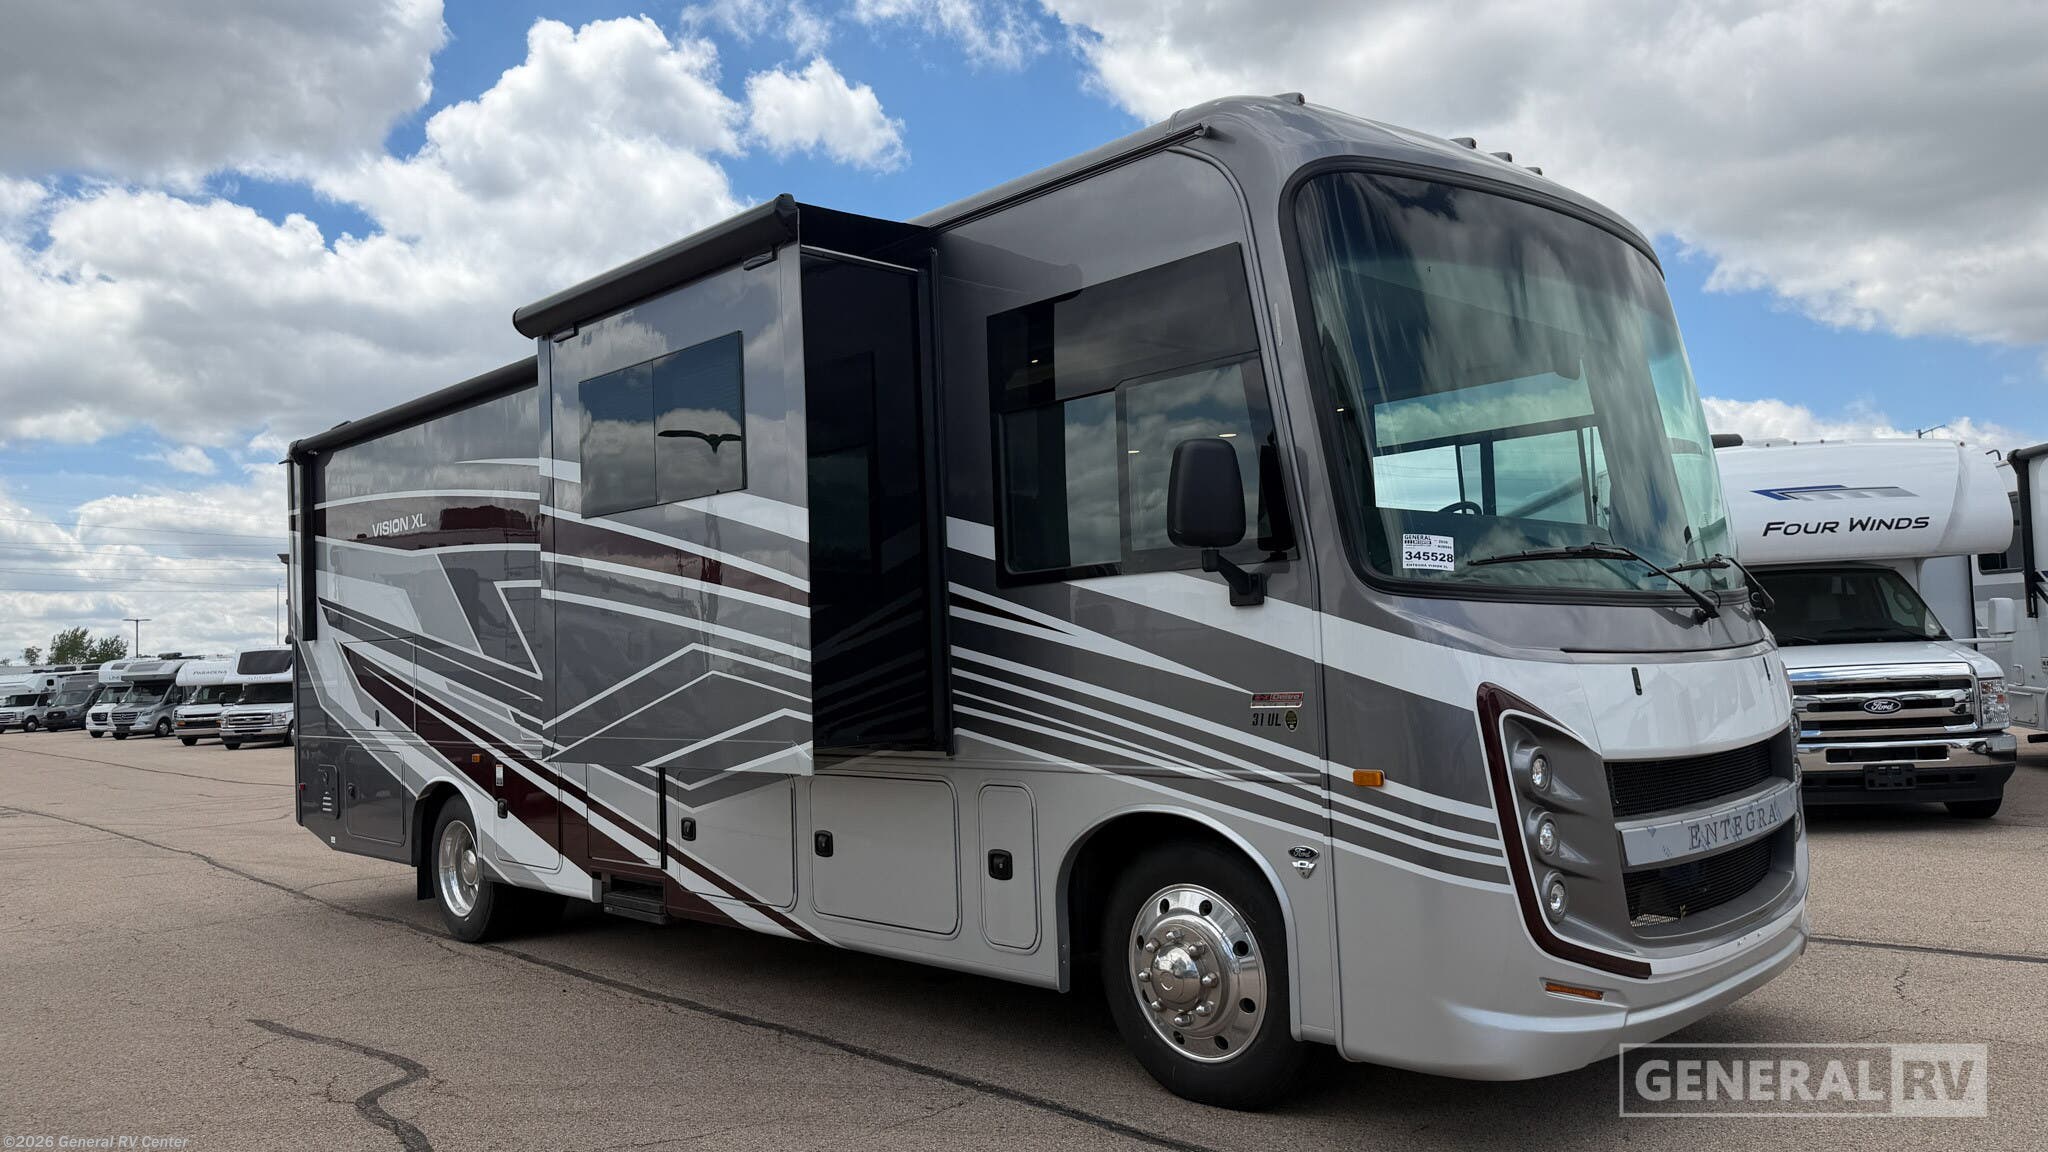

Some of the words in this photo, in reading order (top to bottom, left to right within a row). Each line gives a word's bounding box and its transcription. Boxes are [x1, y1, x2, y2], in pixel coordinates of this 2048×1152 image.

[372, 516, 409, 537] VISION
[411, 513, 427, 529] XL
[1762, 521, 1840, 537] FOUR
[1849, 516, 1930, 532] WINDS
[1404, 550, 1454, 563] 345528
[1871, 700, 1895, 711] Ford
[1252, 712, 1265, 726] 31
[1267, 712, 1282, 727] UL
[1688, 801, 1778, 851] ENTEGRA
